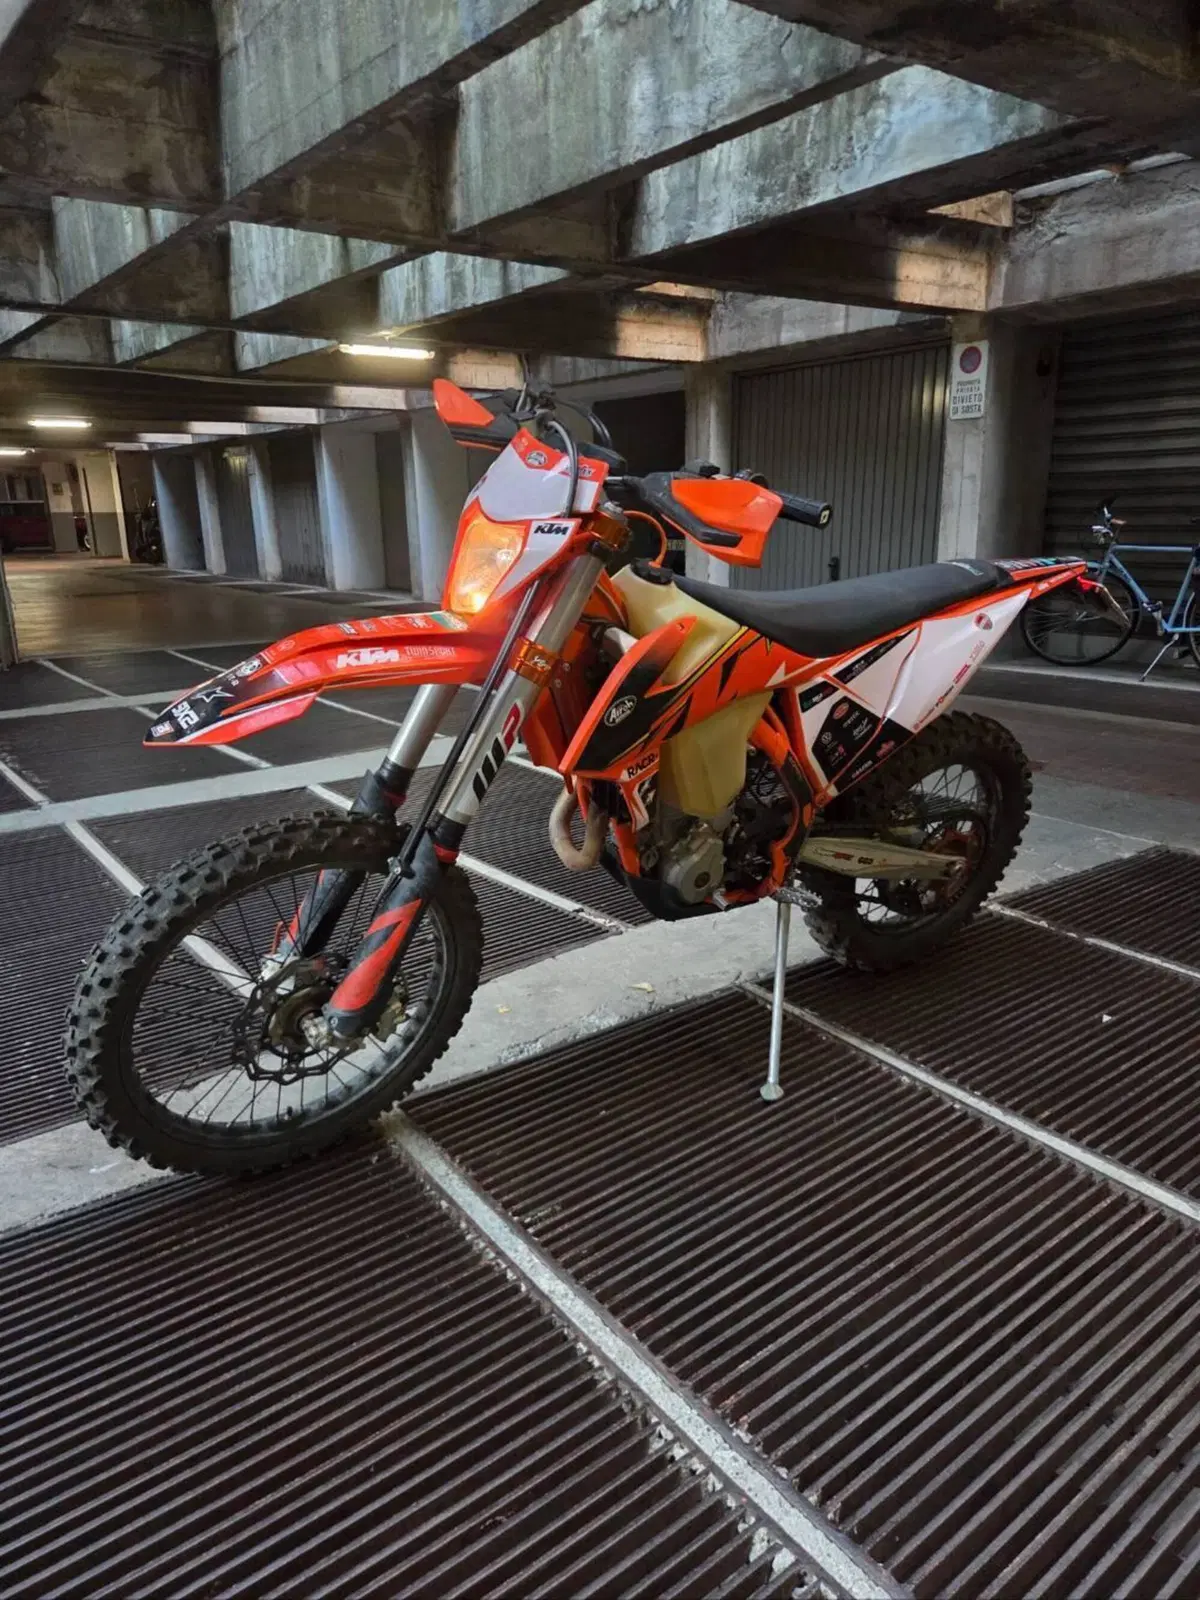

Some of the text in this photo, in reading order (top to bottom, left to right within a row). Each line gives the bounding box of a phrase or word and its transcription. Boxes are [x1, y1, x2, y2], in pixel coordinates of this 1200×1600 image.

[952, 393, 983, 405] DIVIETO
[533, 522, 568, 536] KTM
[336, 647, 400, 669] KTM
[609, 700, 635, 723] Airoh
[626, 753, 657, 779] RACR
